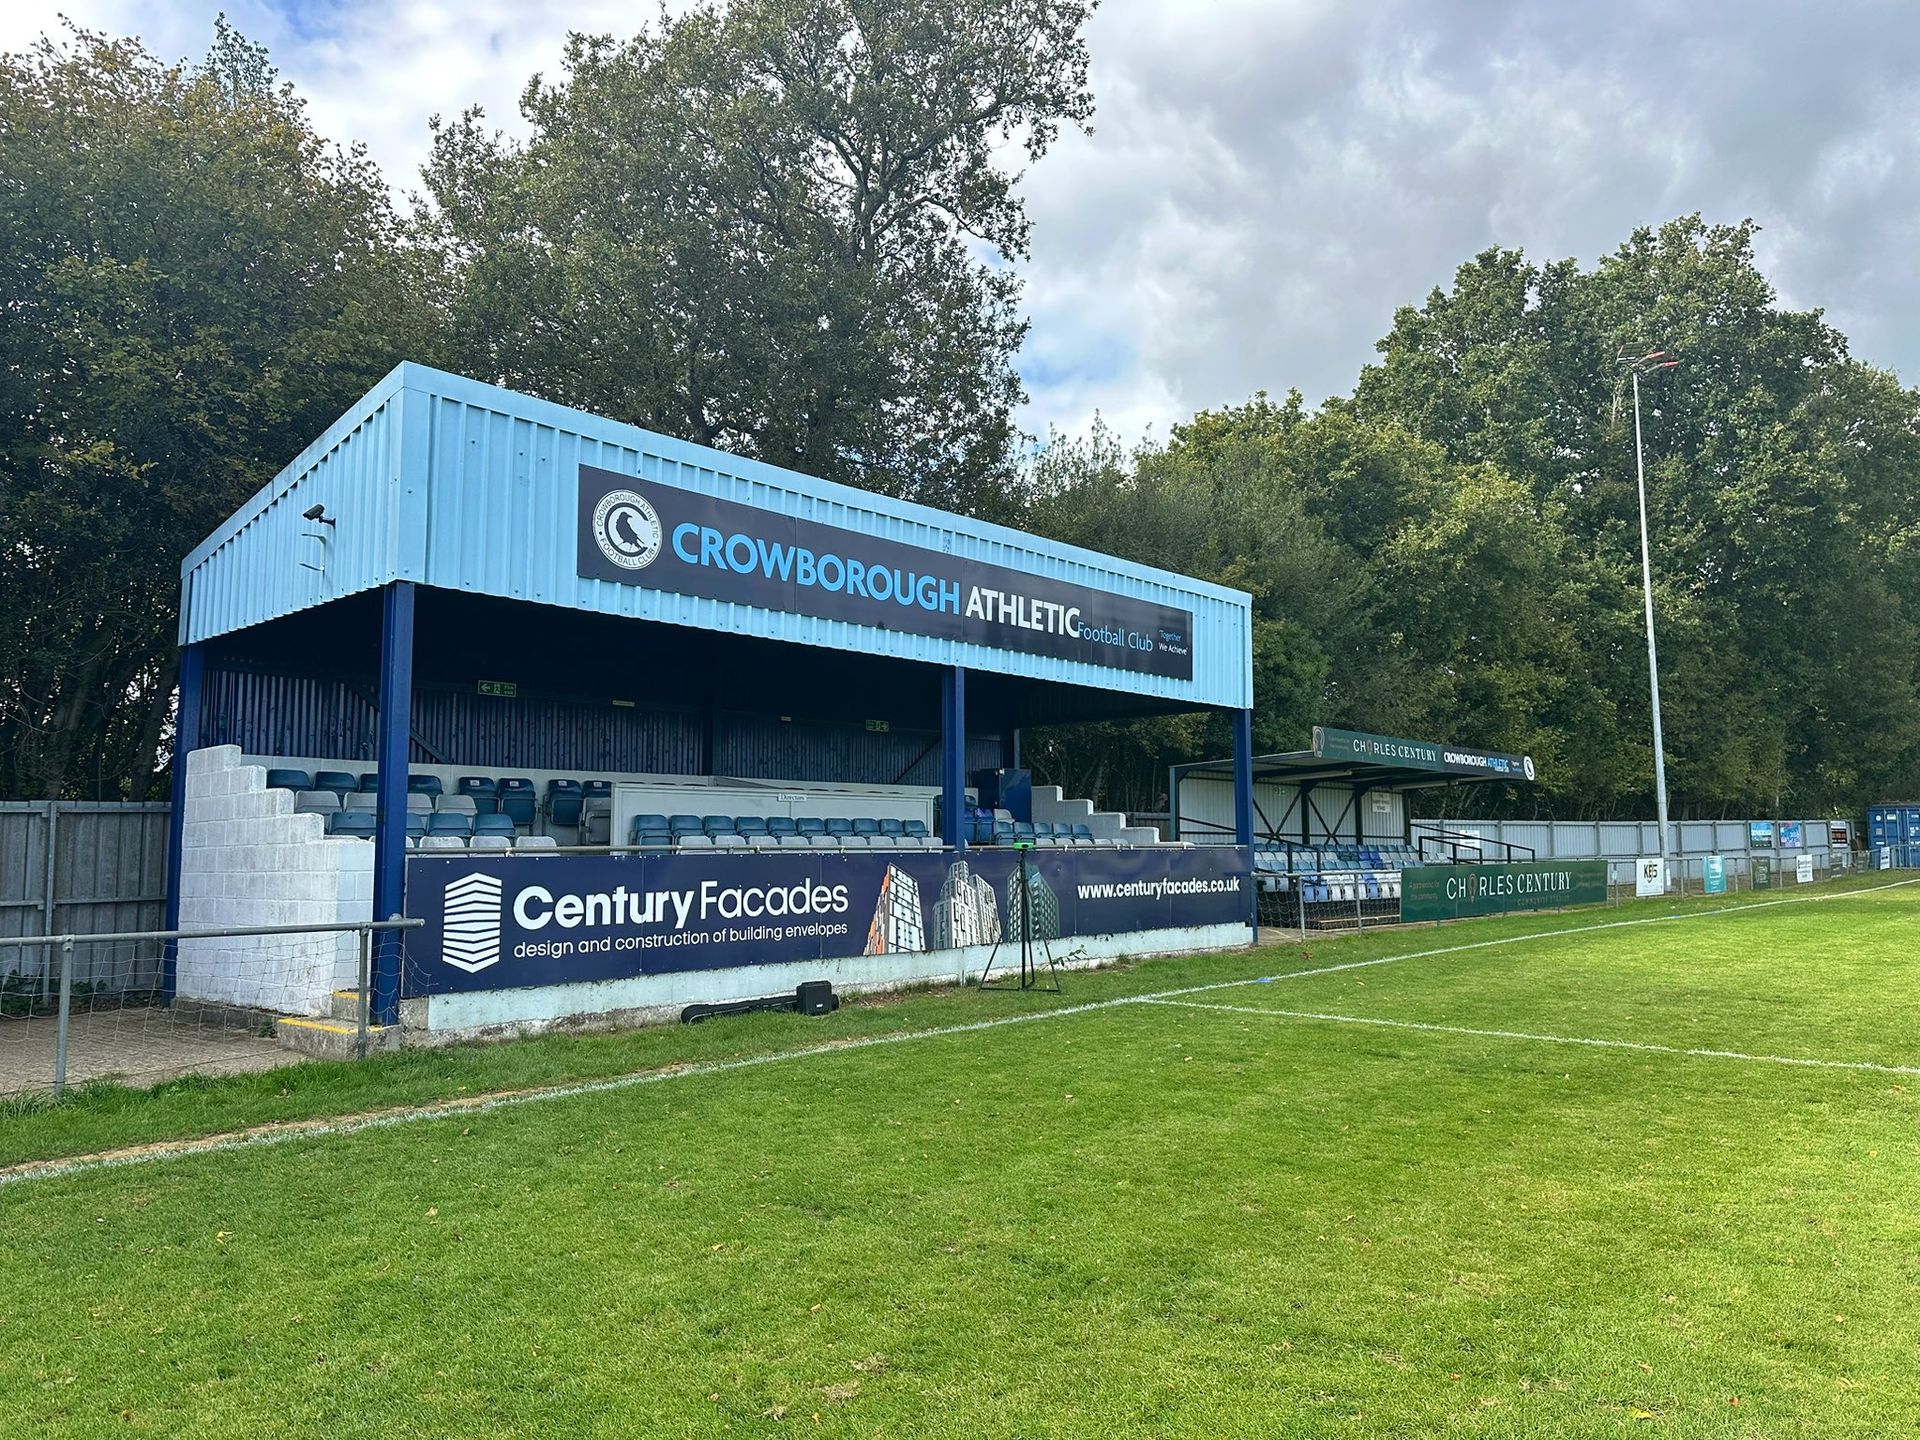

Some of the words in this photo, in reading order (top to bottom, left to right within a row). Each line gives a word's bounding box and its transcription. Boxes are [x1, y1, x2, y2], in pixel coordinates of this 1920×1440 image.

[596, 493, 641, 527] CROWBOROUGH
[639, 502, 659, 540] ATHLETIC
[599, 537, 638, 566] FOOTBALL
[638, 548, 656, 565] CLUB
[671, 522, 960, 615] CROWBOROUGH
[965, 585, 1081, 639] ATHLETIC
[1077, 621, 1125, 647] Football
[1128, 630, 1154, 653] Club
[1158, 641, 1168, 652] We
[1398, 744, 1437, 762] CENTURY
[1443, 751, 1487, 767] CROWBOROUGH
[1077, 875, 1240, 901] www.centuryfacades.co.uk
[1517, 871, 1573, 894] CENTURY
[513, 882, 695, 931] Century
[699, 877, 849, 921] Facades
[513, 936, 574, 960] design
[578, 936, 611, 953] and
[615, 930, 710, 950] construction
[713, 927, 728, 943] of
[729, 924, 783, 946] building
[785, 921, 848, 941] envelopes
